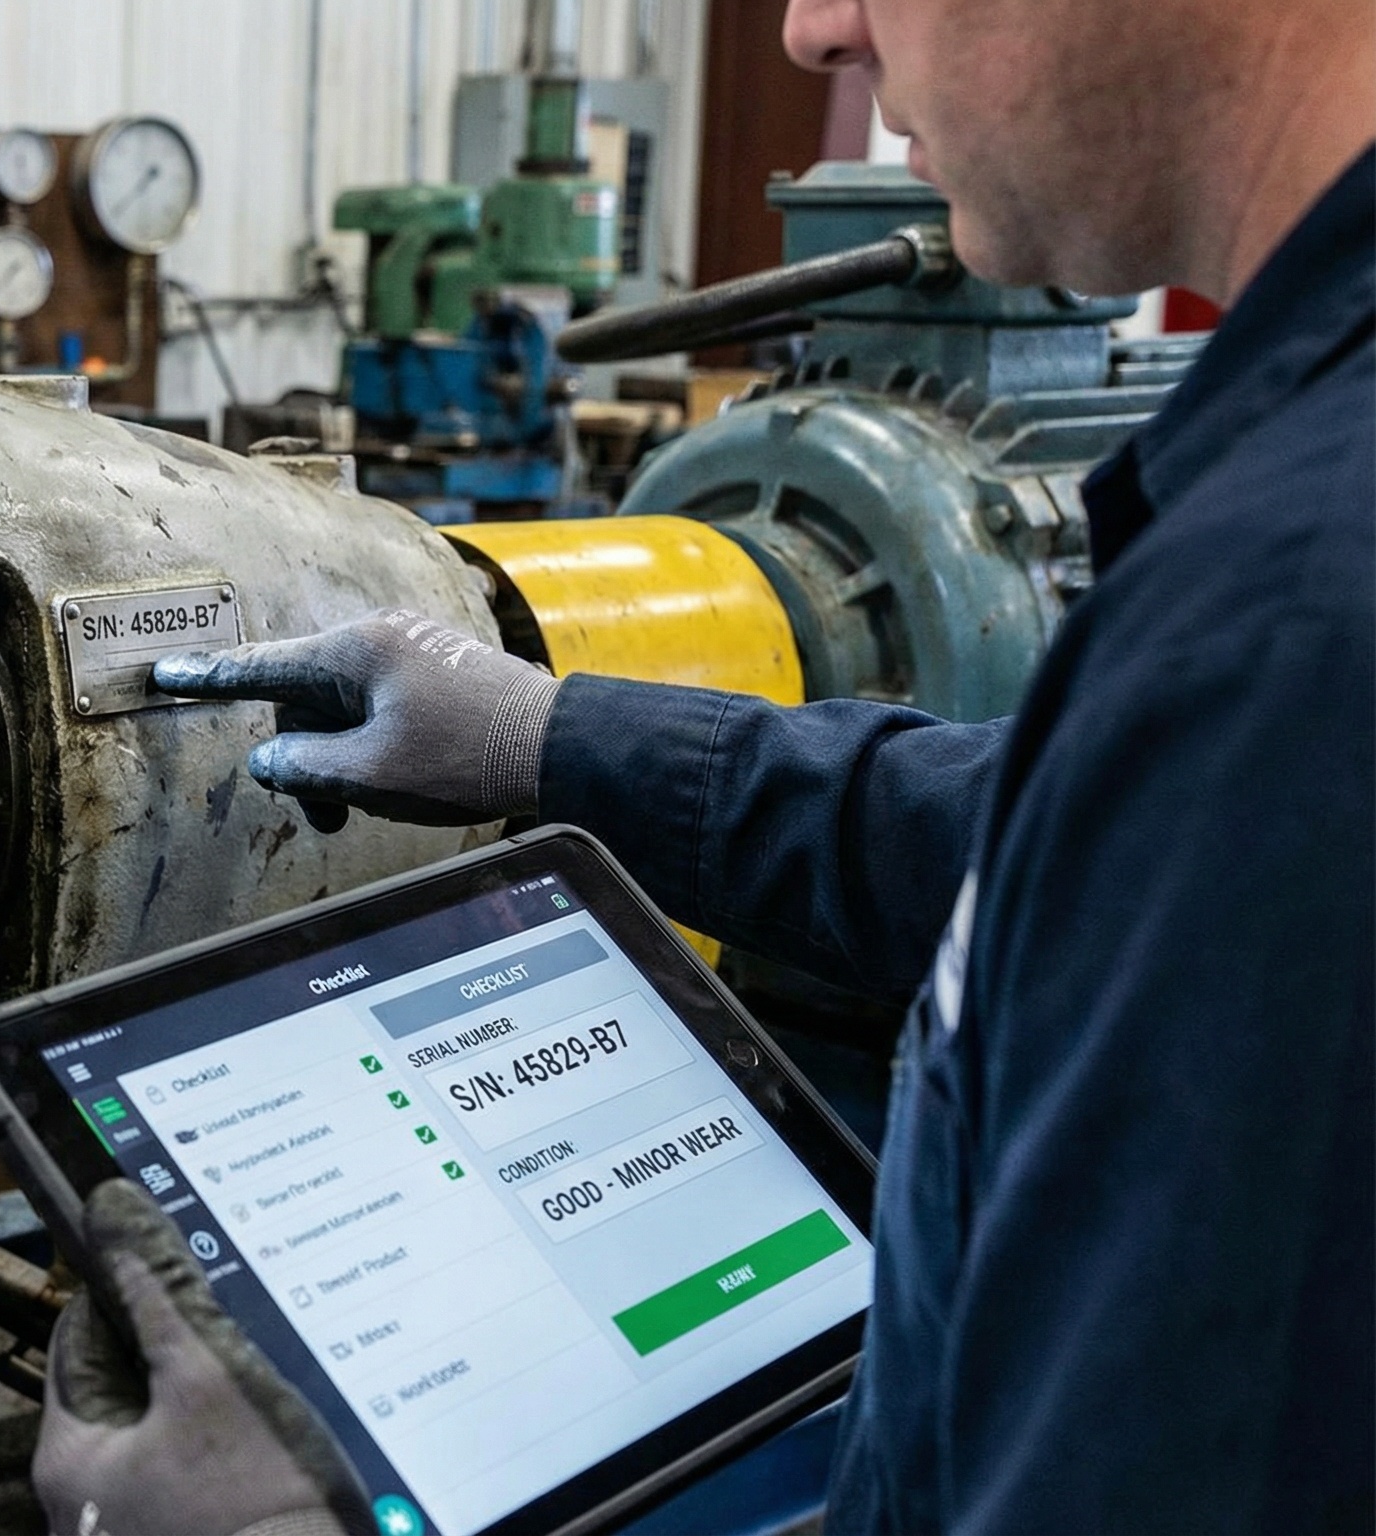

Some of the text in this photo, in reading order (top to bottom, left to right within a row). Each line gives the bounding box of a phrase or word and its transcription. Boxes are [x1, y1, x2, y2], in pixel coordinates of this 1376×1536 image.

[82, 603, 220, 641] S/N: 45829-B7
[309, 963, 370, 996] Checklist
[459, 963, 529, 1001] CHECKLIST
[407, 1016, 518, 1070] SERIAL NUMBER:
[449, 1018, 628, 1113] S/N: 45829-B7
[498, 1140, 579, 1185] CONDITION:
[542, 1180, 602, 1222] GOOD
[613, 1142, 686, 1191] MINOR
[679, 1115, 743, 1159] WEAR
